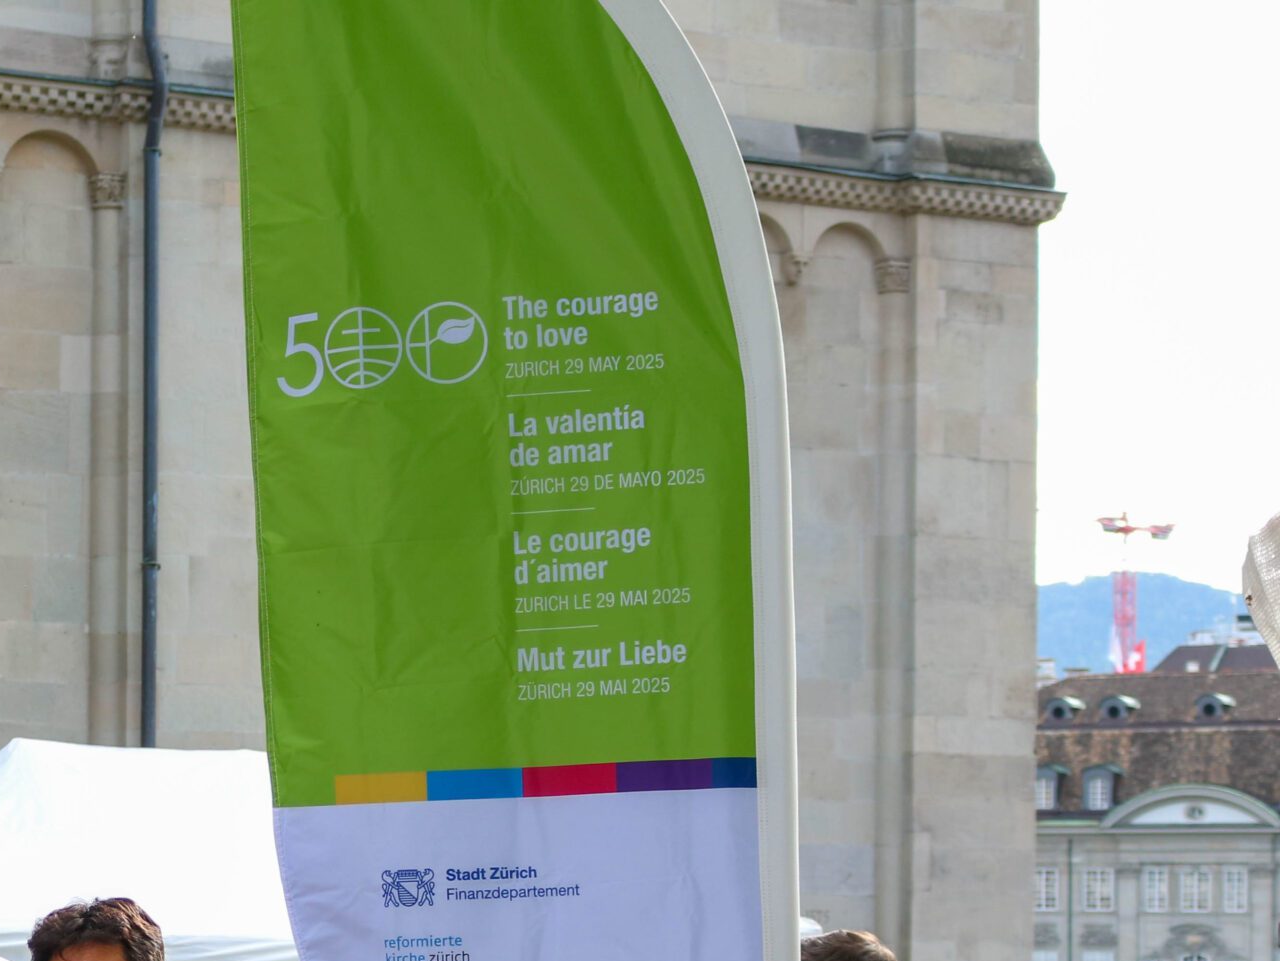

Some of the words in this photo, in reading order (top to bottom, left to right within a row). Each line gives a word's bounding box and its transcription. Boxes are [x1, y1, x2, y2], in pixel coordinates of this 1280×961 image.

[502, 295, 547, 320] The
[556, 291, 658, 317] courage
[504, 327, 528, 350] to
[536, 324, 588, 347] love
[506, 360, 559, 378] ZURICH
[565, 358, 583, 374] 29
[589, 356, 620, 372] MAY
[627, 354, 664, 370] 2025
[509, 413, 537, 436] La
[546, 404, 644, 434] valentía
[510, 443, 539, 466] de
[548, 442, 613, 464] amar
[511, 475, 565, 495] ZÚRICH
[570, 476, 589, 492] 29
[594, 474, 613, 490] DE
[619, 471, 661, 488] MAYO
[667, 469, 705, 485] 2025
[514, 531, 541, 555] Le
[550, 528, 651, 553] courage
[516, 595, 569, 613] ZURICH
[574, 593, 591, 609] LE
[597, 592, 615, 608] 29
[620, 591, 647, 606] MAI
[653, 588, 691, 604] 2025
[518, 647, 565, 671] Mut
[573, 648, 611, 668] zur
[620, 640, 687, 665] Liebe
[518, 682, 571, 700] ZÜRICH
[577, 682, 595, 697] 29
[600, 680, 627, 695] MAI
[632, 677, 670, 694] 2025
[446, 868, 486, 881] Stadt
[490, 866, 537, 879] Zürich
[447, 884, 580, 901] Finanzdepartement
[385, 935, 462, 950] reformierte
